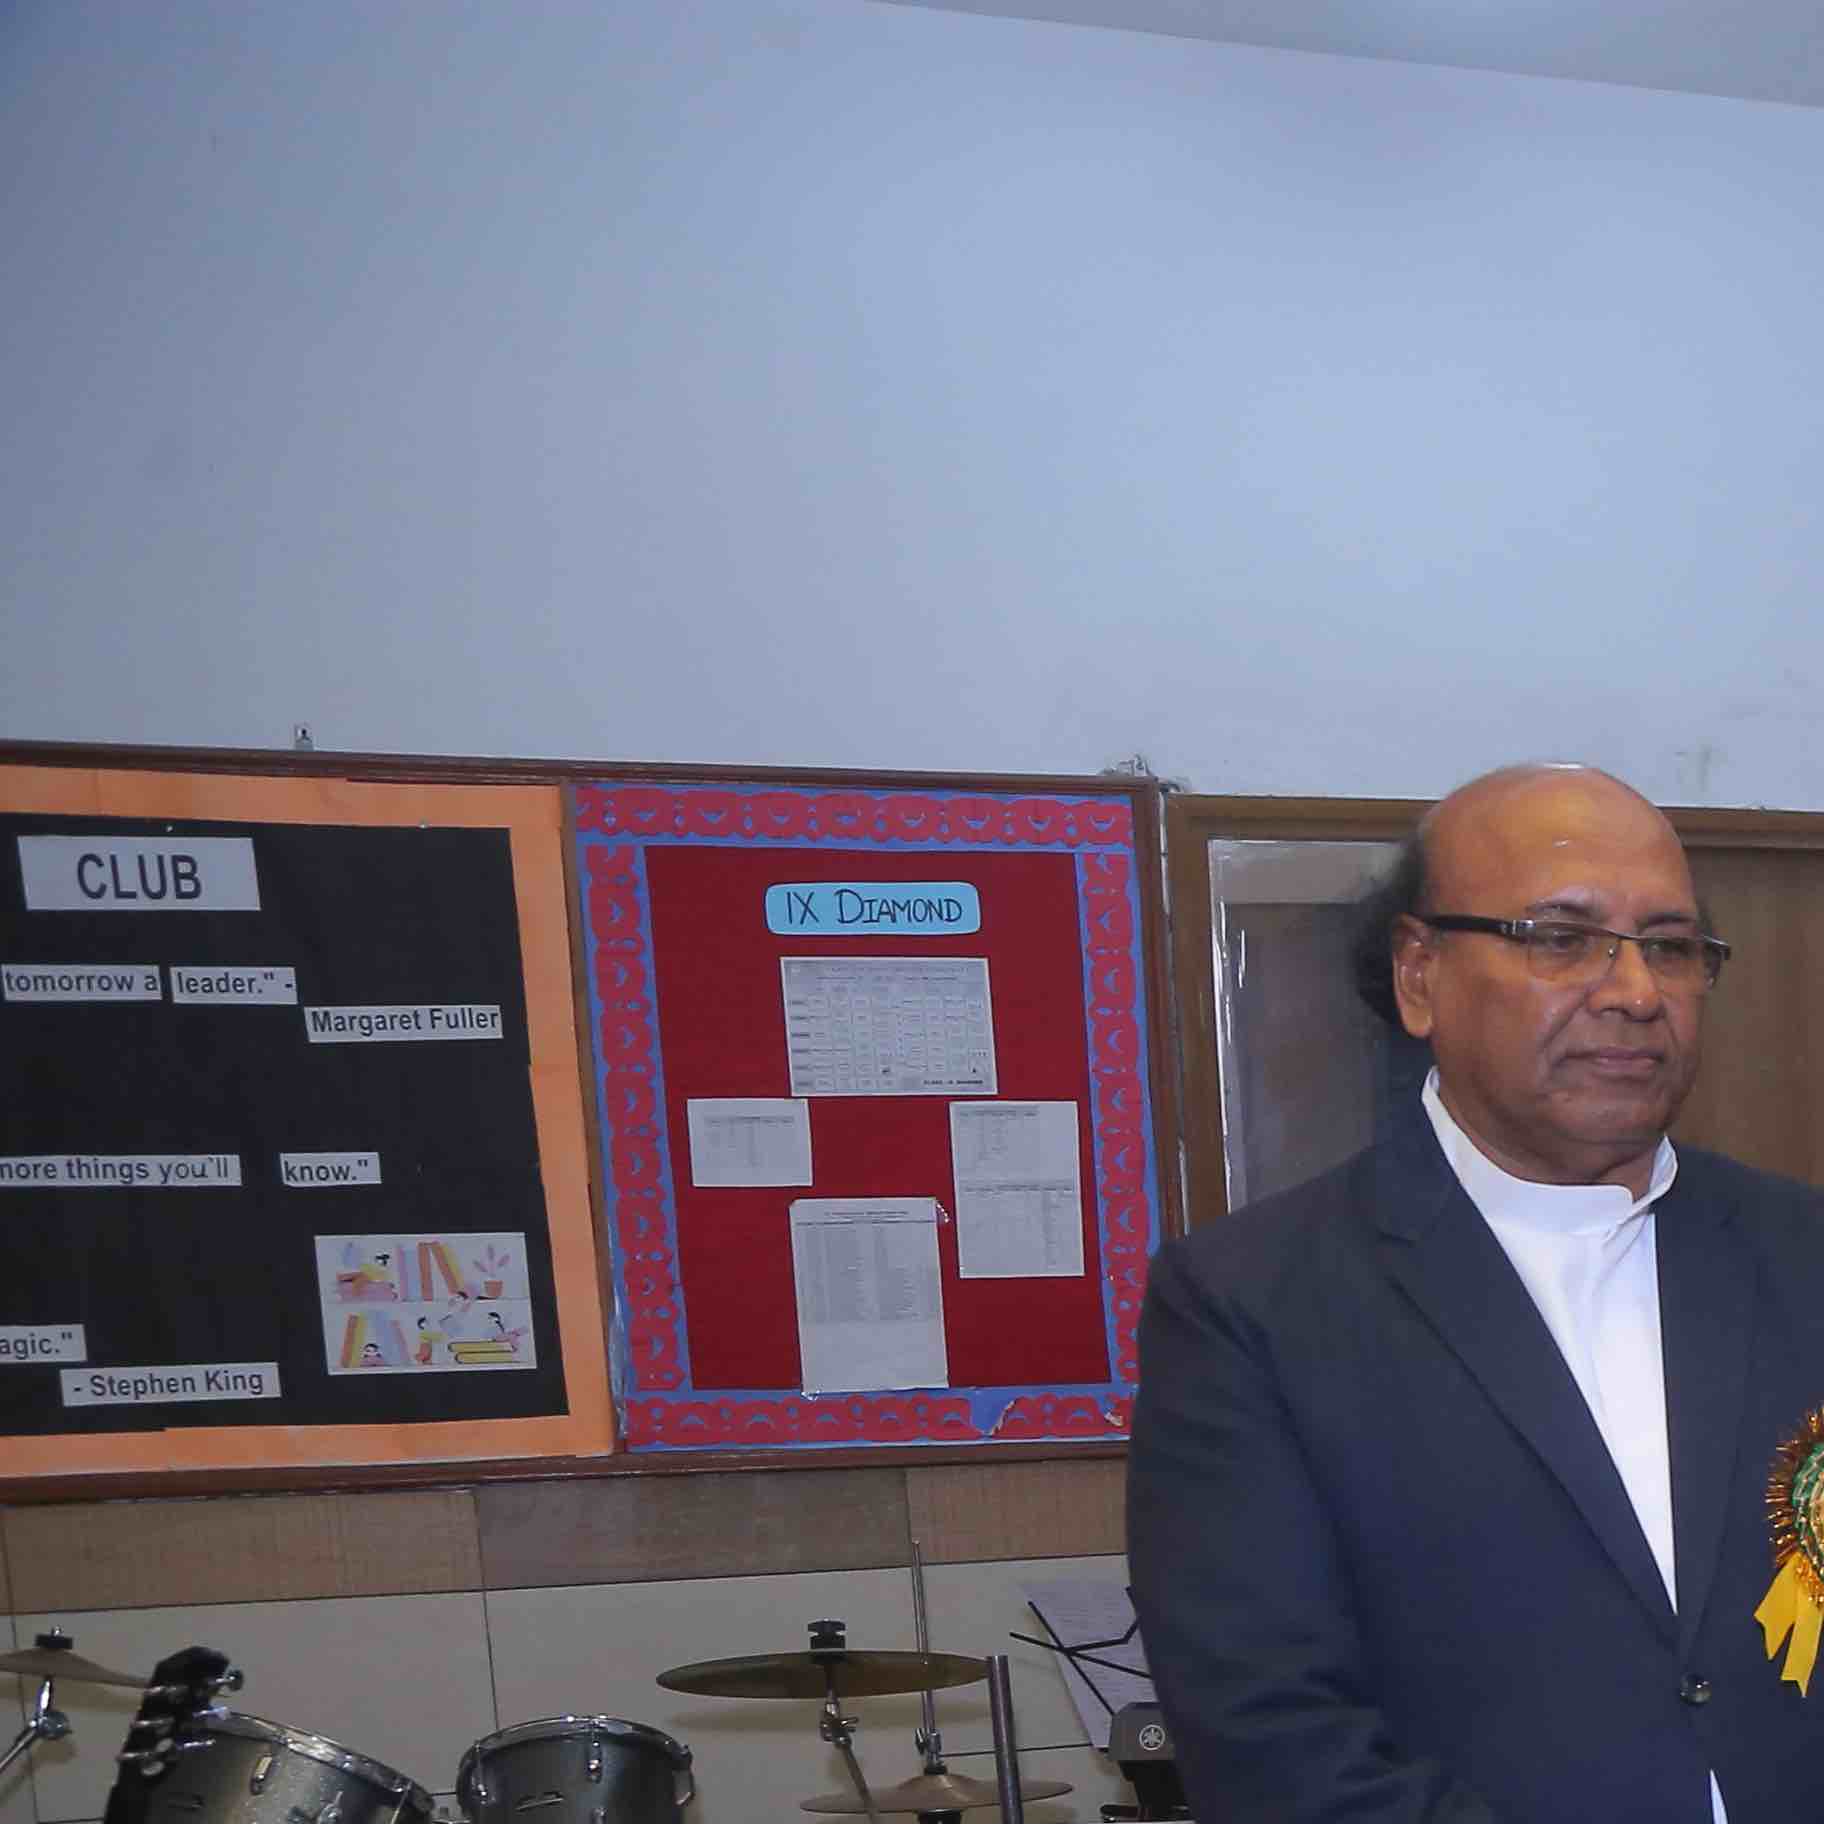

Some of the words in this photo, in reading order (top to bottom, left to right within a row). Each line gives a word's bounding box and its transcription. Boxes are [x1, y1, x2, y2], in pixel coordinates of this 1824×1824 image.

[77, 853, 202, 900] CLUB
[786, 891, 820, 925] IX
[4, 971, 134, 993] tomorrow
[144, 975, 158, 992] a
[311, 1009, 422, 1037] Margaret
[430, 1007, 499, 1030] Fuller
[66, 1157, 150, 1184] things
[90, 1373, 196, 1400] Stephen
[205, 1370, 264, 1395] King
